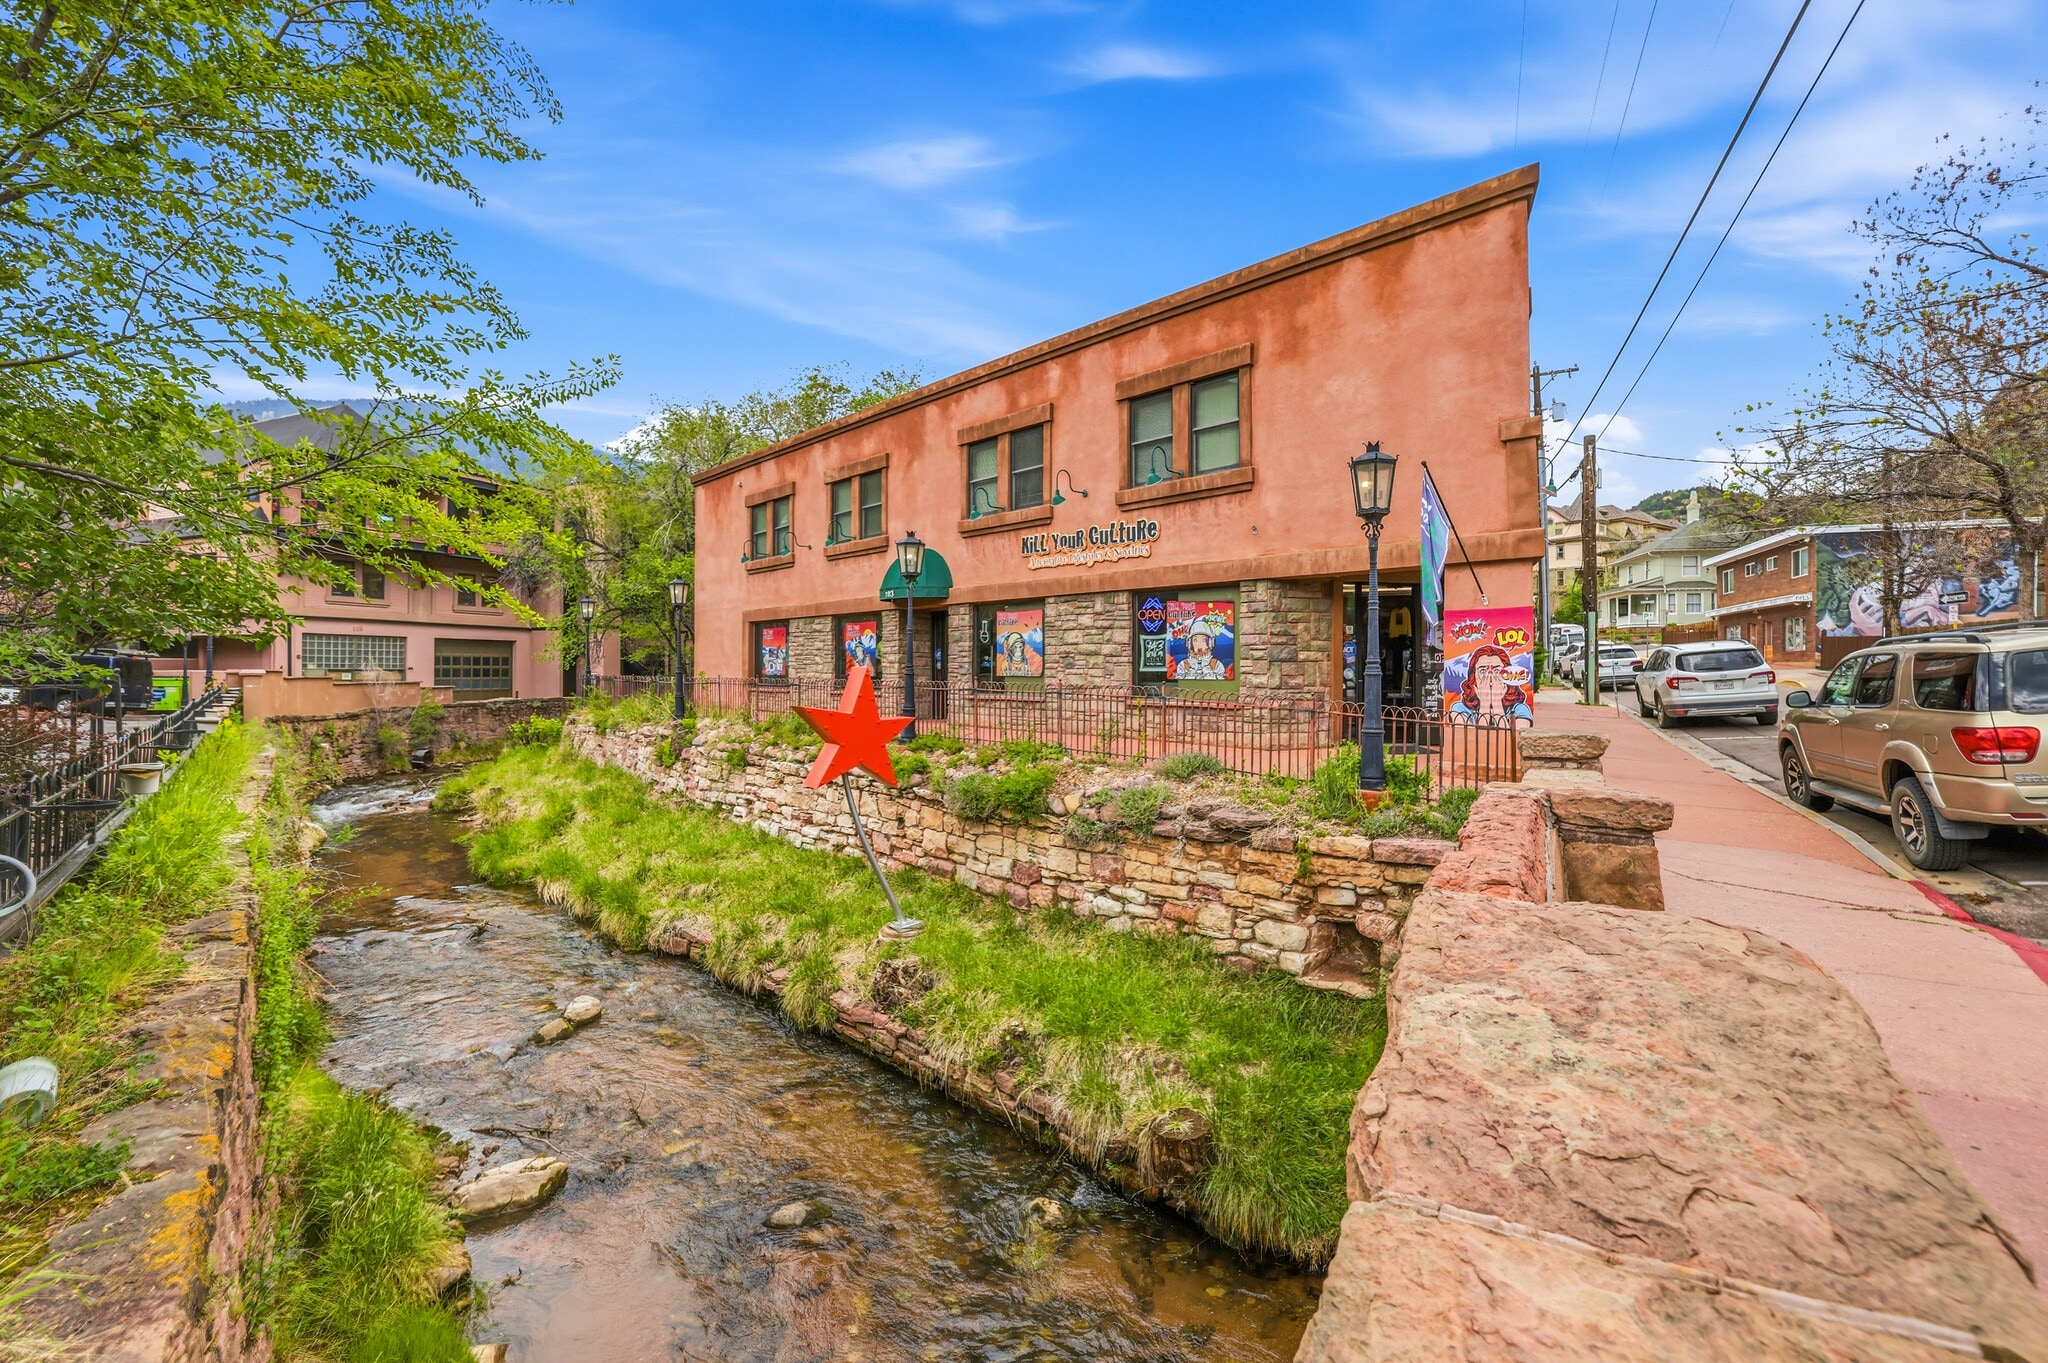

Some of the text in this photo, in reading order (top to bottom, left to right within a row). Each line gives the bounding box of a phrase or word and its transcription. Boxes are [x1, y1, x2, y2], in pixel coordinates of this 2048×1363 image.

[1137, 609, 1165, 620] OPEN
[1496, 630, 1527, 646] LOL
[1500, 669, 1530, 681] OMG!
